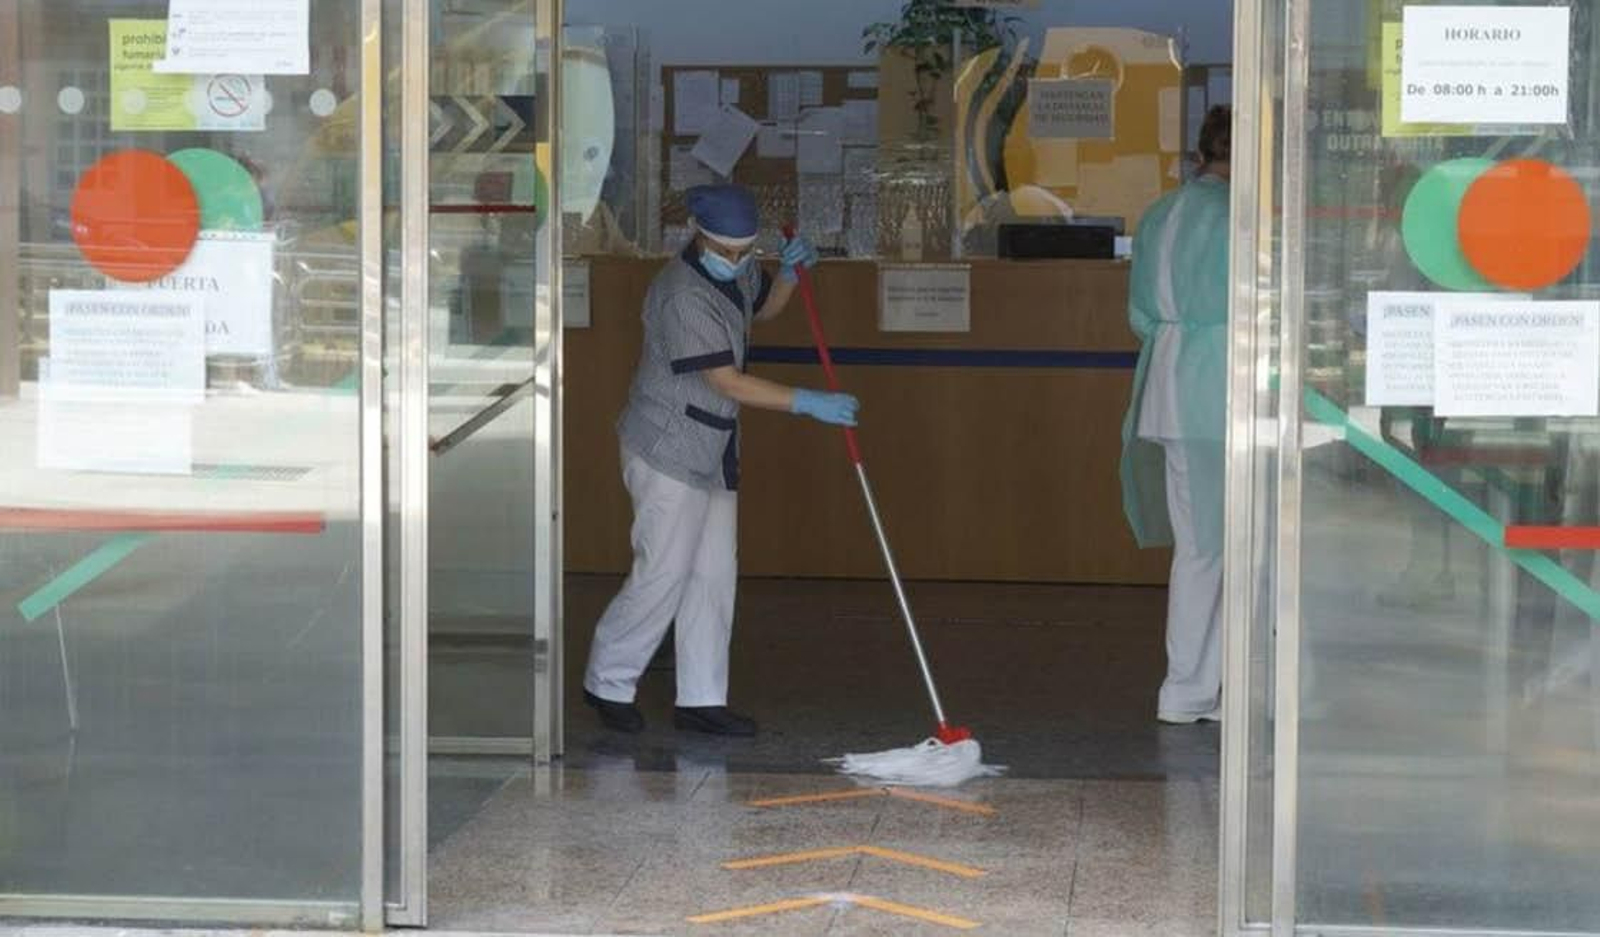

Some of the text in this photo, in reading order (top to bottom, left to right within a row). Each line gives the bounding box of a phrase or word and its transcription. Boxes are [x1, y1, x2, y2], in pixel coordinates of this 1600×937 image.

[1444, 27, 1522, 42] HORARIO
[1406, 83, 1560, 98] De 08:00 h a 21:00h
